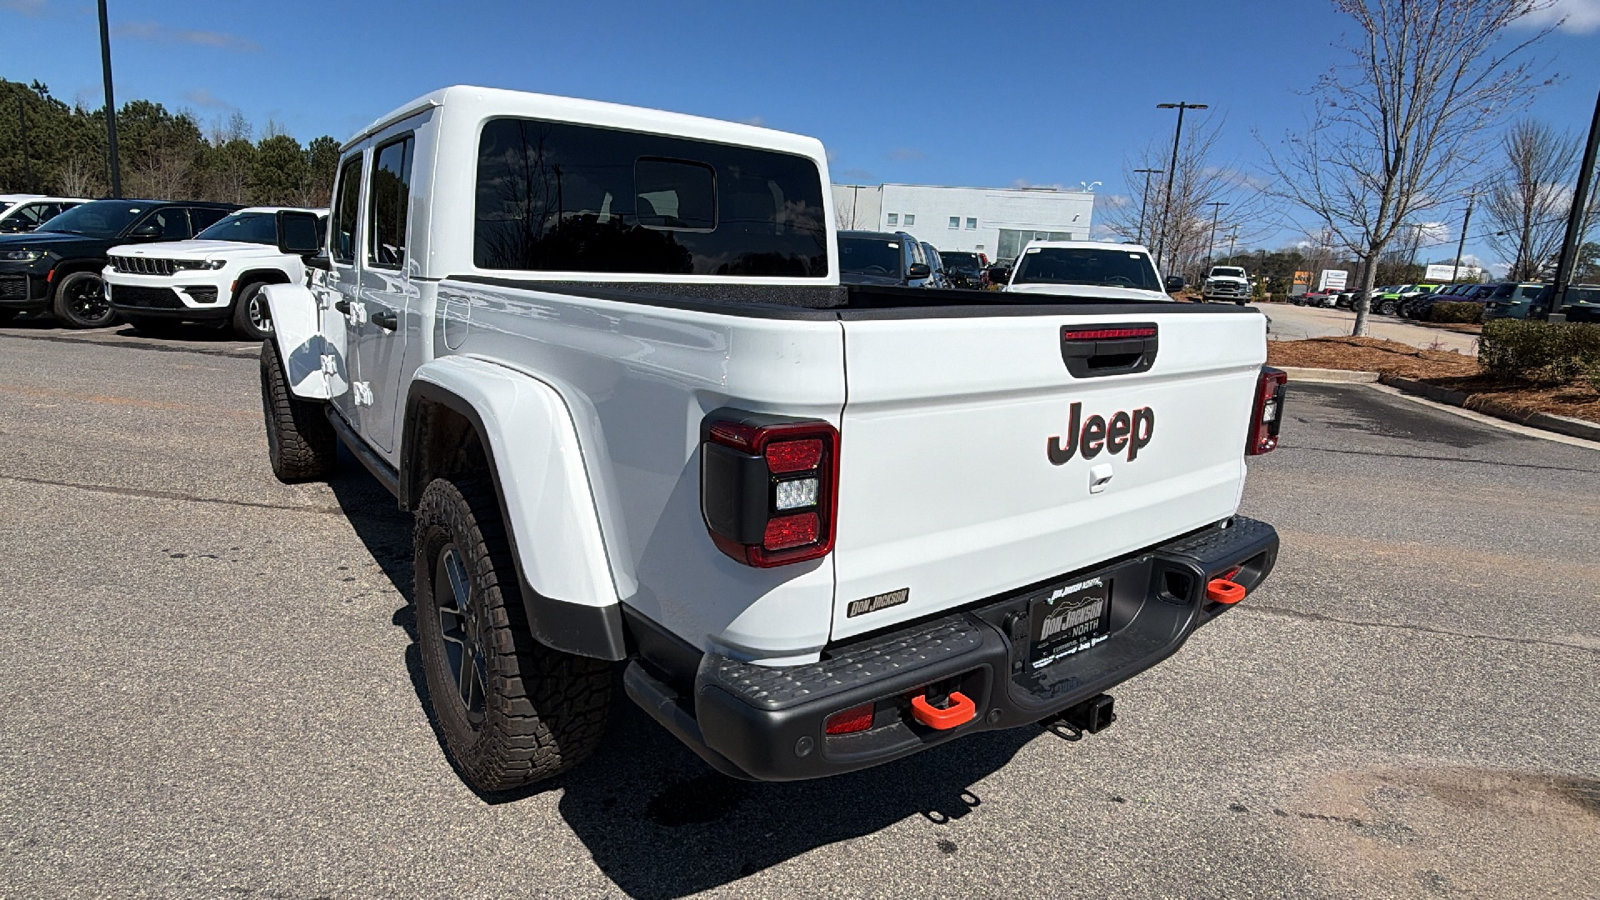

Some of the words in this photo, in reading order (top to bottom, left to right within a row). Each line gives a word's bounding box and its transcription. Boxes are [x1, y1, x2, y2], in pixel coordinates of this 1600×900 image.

[1047, 401, 1154, 466] Jeep
[850, 599, 870, 617] DON
[869, 589, 907, 612] JACKSON
[1040, 615, 1062, 641] DON
[1061, 601, 1103, 631] JACKSON
[1072, 618, 1099, 637] NORTH
